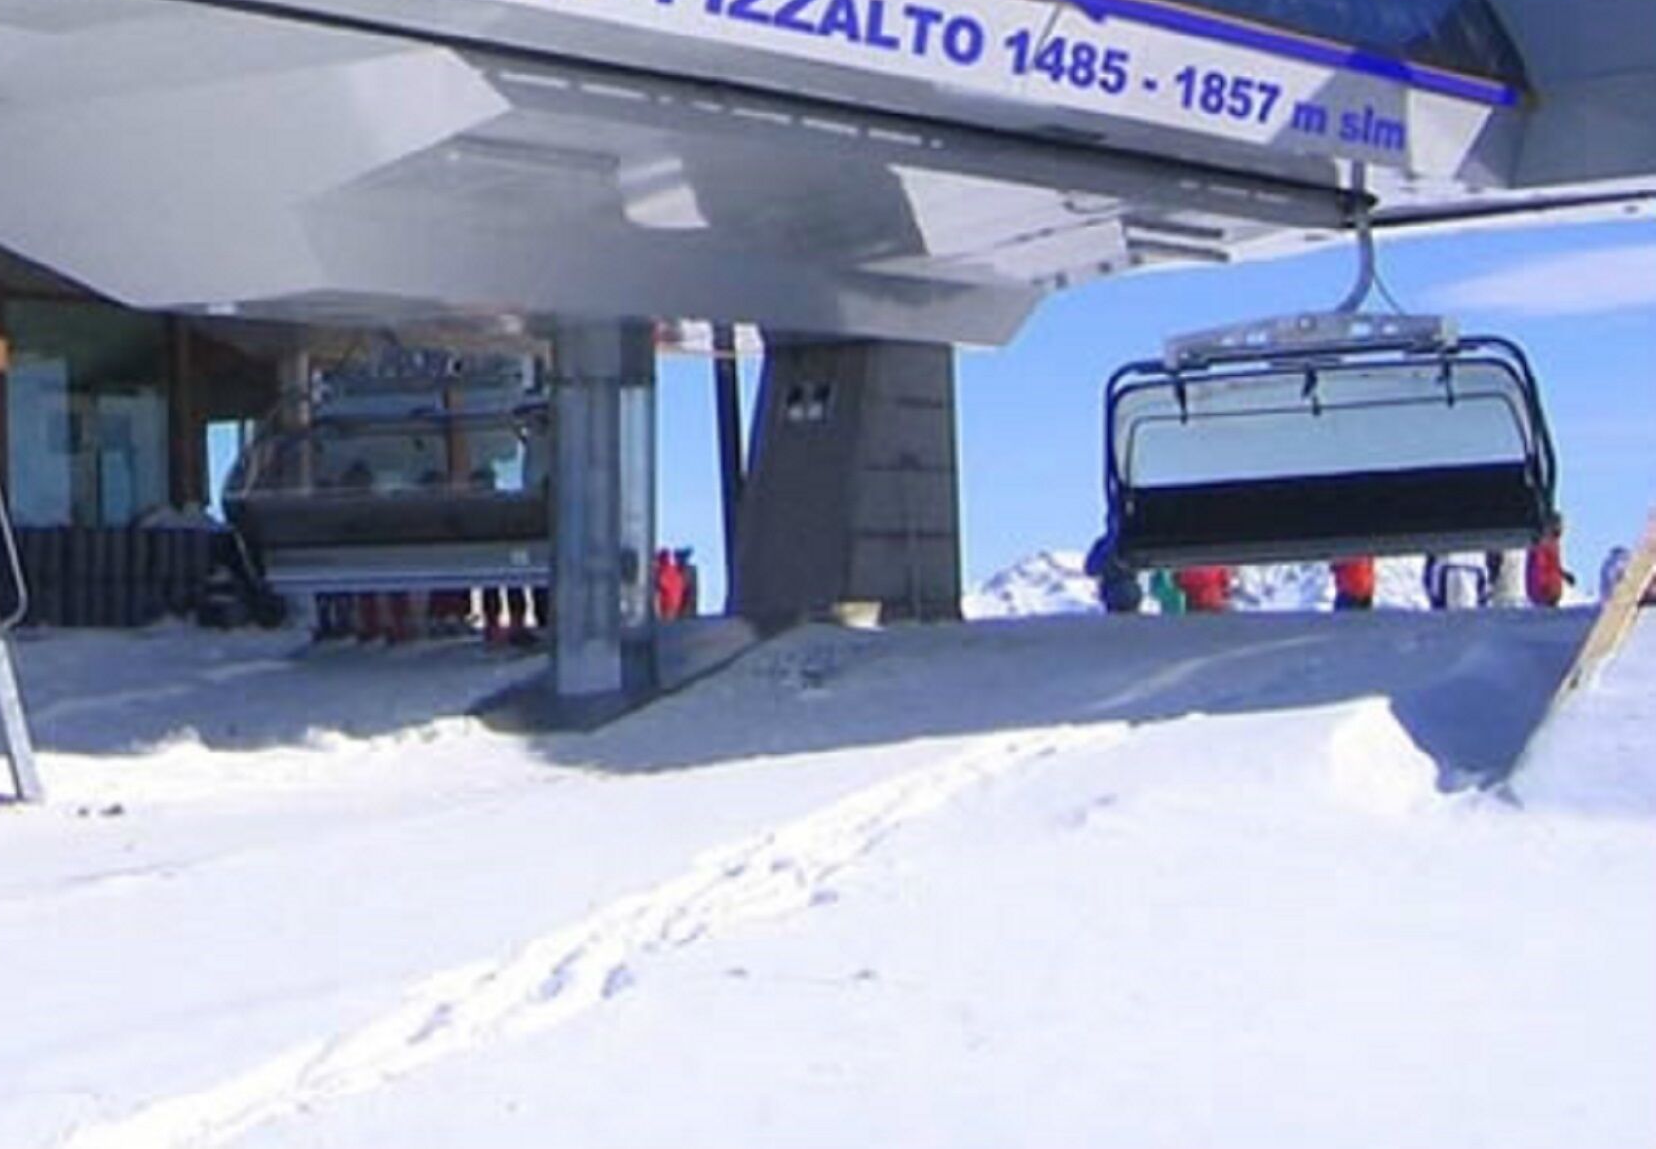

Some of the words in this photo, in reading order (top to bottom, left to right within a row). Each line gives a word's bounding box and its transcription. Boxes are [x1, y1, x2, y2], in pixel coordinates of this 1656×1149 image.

[1005, 29, 1129, 94] 1485
[1143, 79, 1158, 91] -
[1175, 67, 1280, 124] 1857
[1291, 101, 1326, 134] m
[1339, 105, 1405, 151] slm
